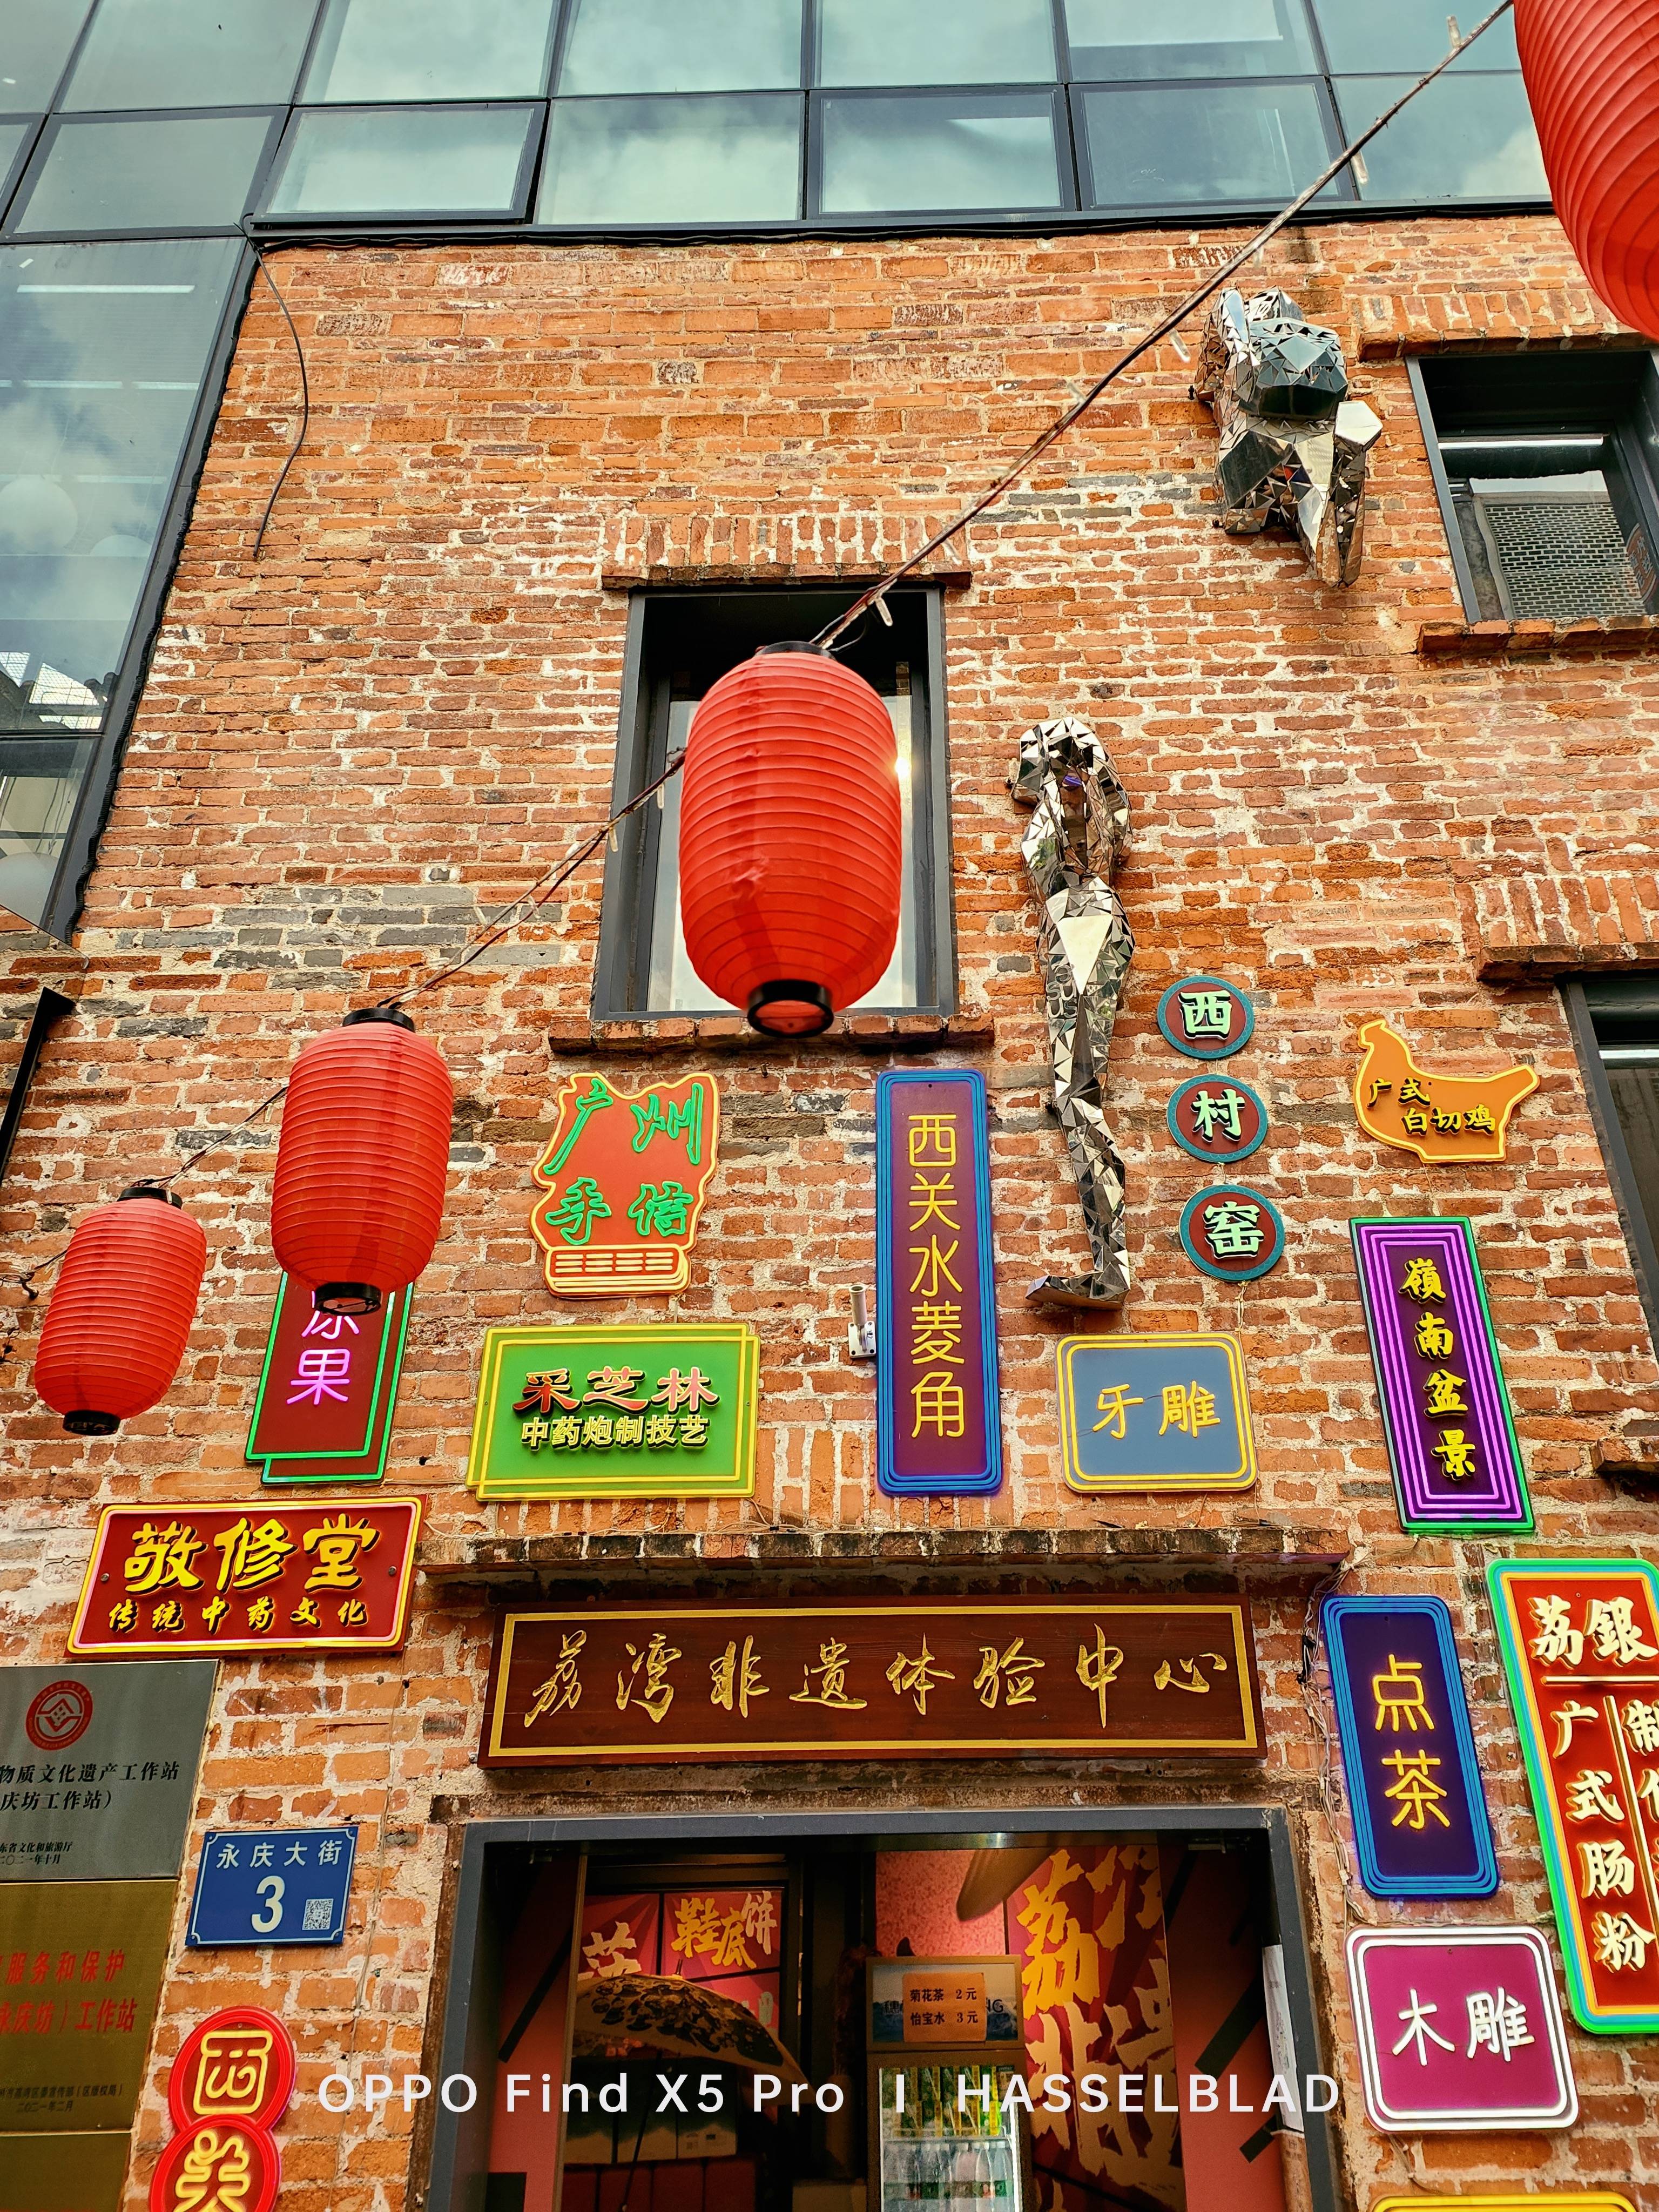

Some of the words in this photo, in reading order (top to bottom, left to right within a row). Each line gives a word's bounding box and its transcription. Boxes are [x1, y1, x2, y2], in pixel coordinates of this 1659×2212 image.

[1366, 1077, 1431, 1108] 广式
[543, 1077, 703, 1176] 广州
[1401, 1104, 1495, 1136] 白切鸡
[908, 1113, 965, 1438] 西关水菱角
[512, 1365, 720, 1415] 采芝林
[1092, 1380, 1220, 1439] 牙雕
[521, 1415, 710, 1451] 中药炮制技艺
[124, 1513, 380, 1595] 敬修堂
[108, 1595, 368, 1634] 传统中药文化
[1372, 1654, 1451, 1830] 点茶
[216, 1839, 343, 1870] 永庆大街
[1550, 1700, 1656, 1973] 广式肠粉
[251, 1875, 286, 1933] 3
[671, 1890, 778, 1969] 鞋底饼
[0, 1949, 125, 1986] 服务和保护
[909, 1988, 944, 2003] 菊花茶
[910, 2012, 946, 2026] 怡宝水
[1392, 1986, 1535, 2067] 木雕
